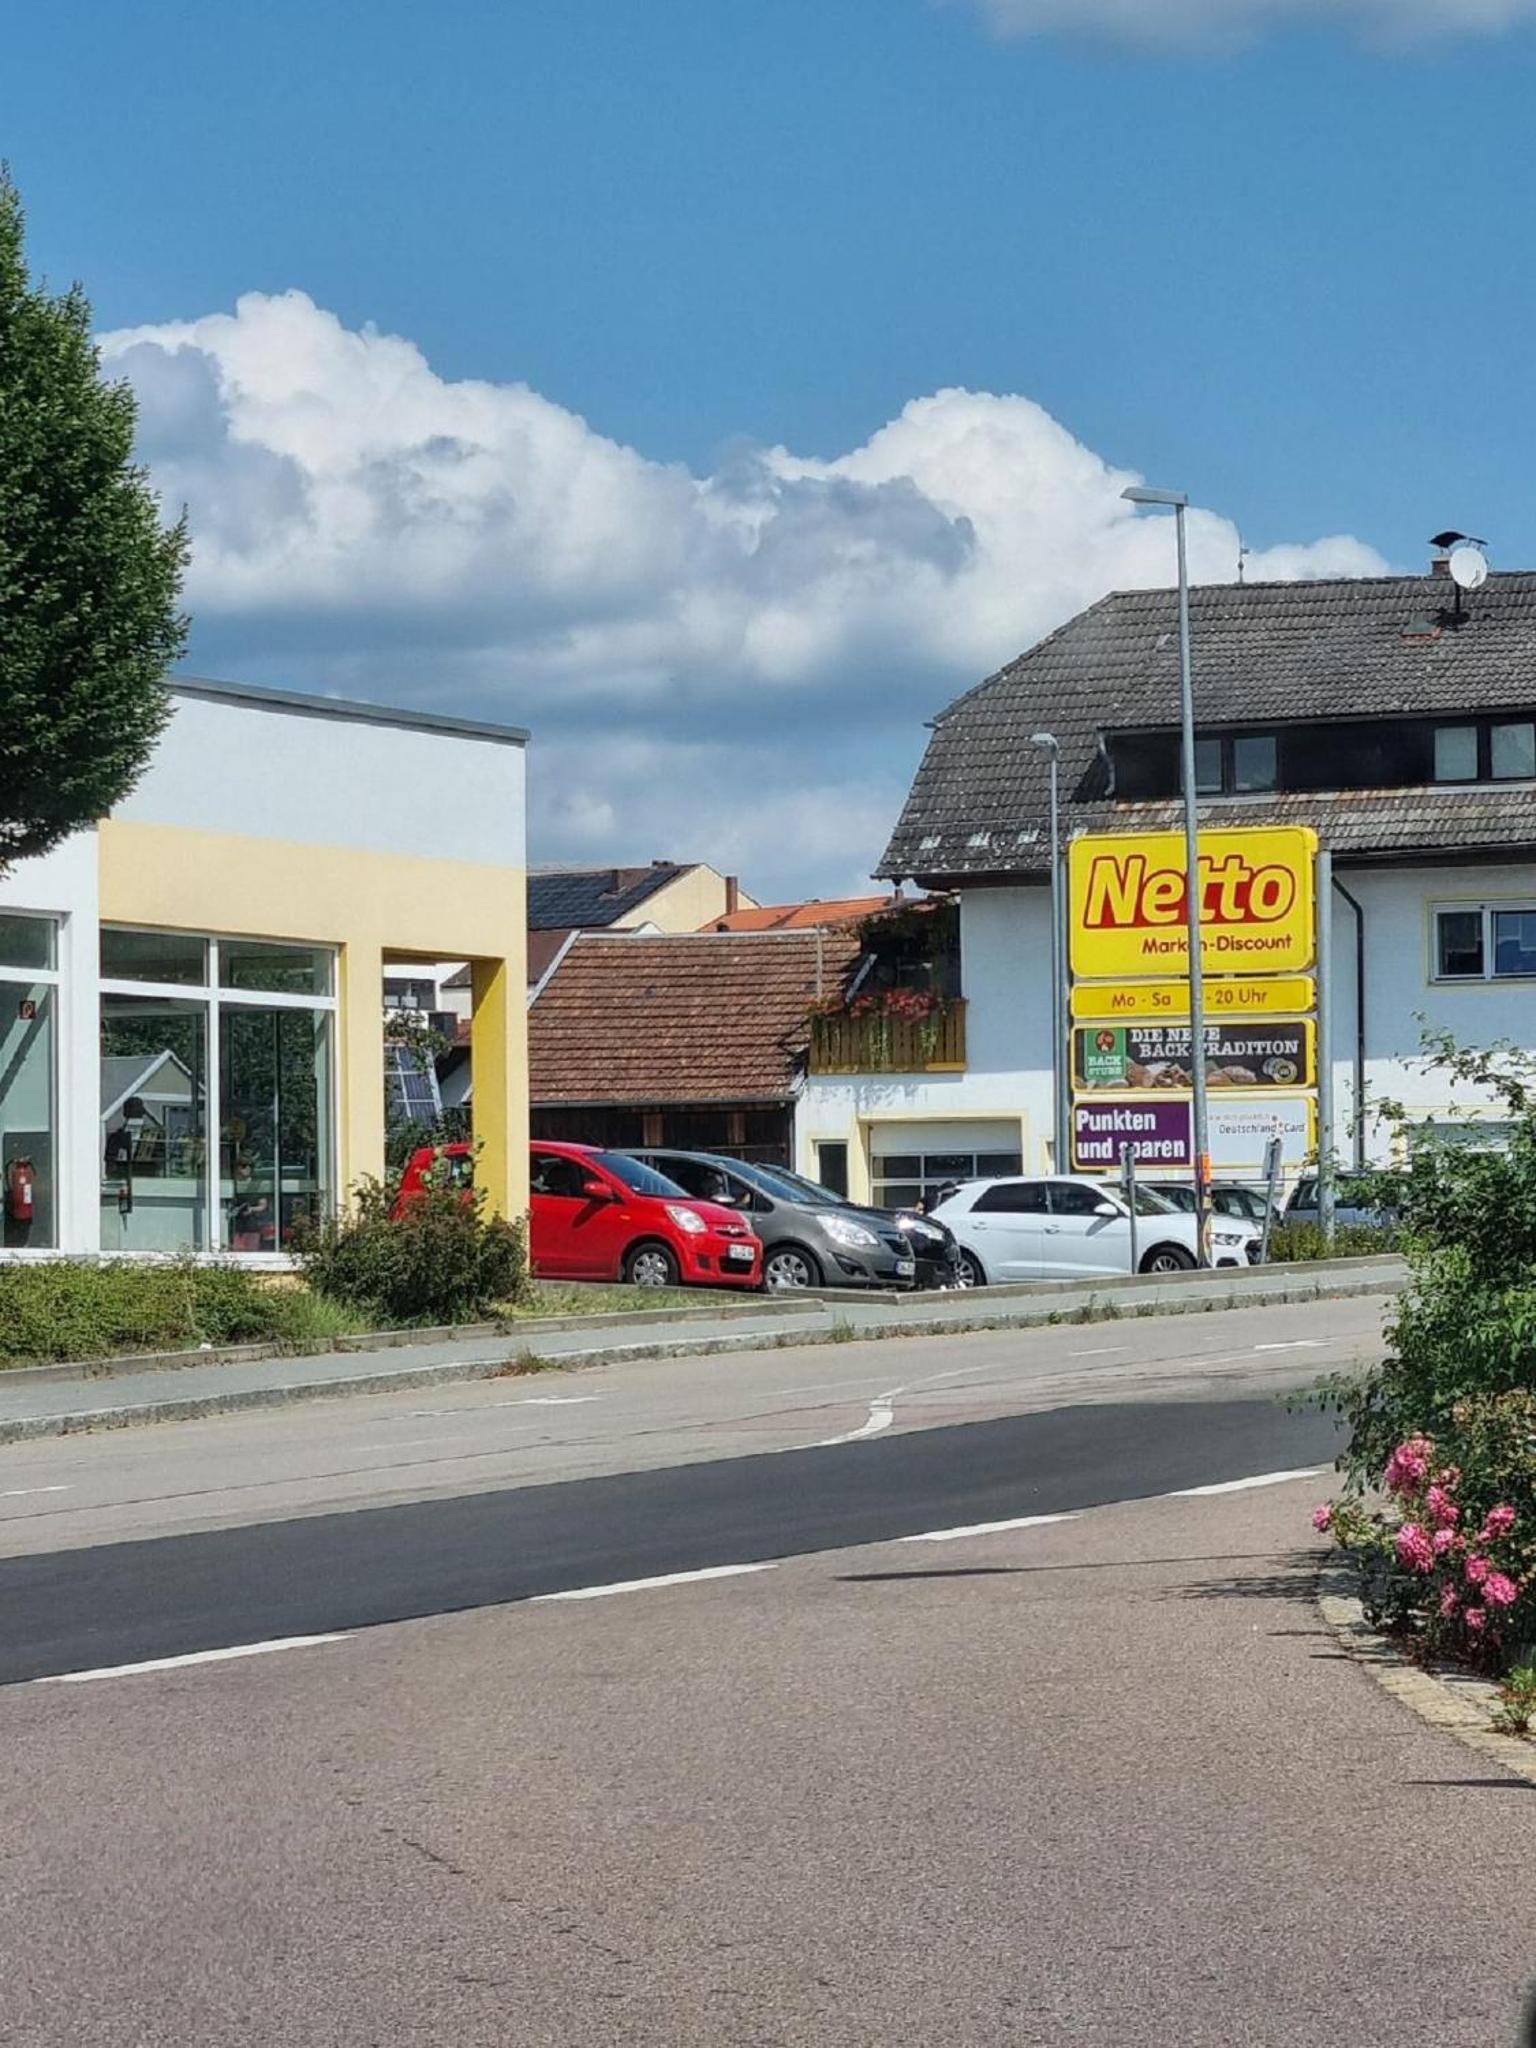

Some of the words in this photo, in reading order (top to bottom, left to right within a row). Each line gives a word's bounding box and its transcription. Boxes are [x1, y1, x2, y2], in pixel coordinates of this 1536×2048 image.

[1084, 854, 1295, 929] Netto
[1142, 934, 1292, 954] Markn-Discount
[1112, 994, 1136, 1008] Mo
[1152, 992, 1171, 1006] Sa
[1215, 989, 1233, 1004] 20
[1239, 988, 1267, 1004] Uhr
[1131, 1029, 1162, 1043] DIE
[1088, 1056, 1121, 1066] BACK
[1076, 1109, 1156, 1132] Punkten
[1077, 1139, 1113, 1159] und
